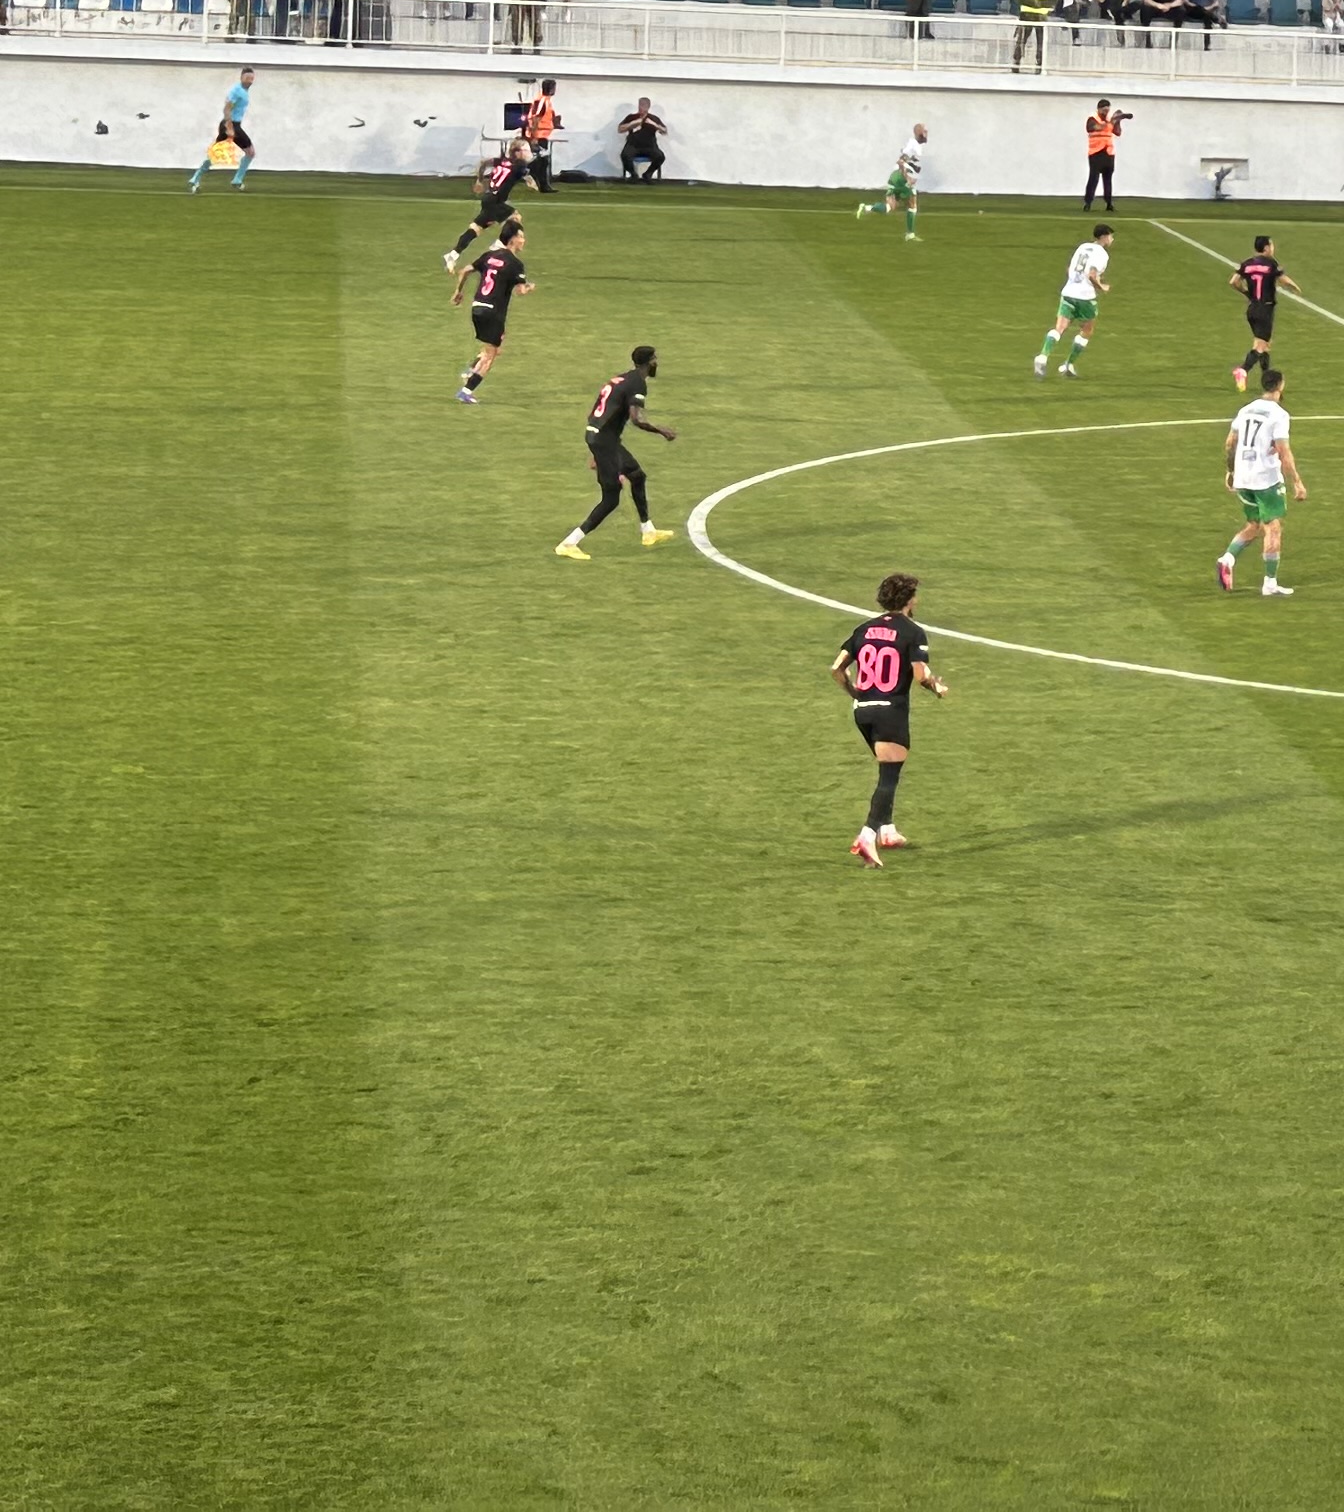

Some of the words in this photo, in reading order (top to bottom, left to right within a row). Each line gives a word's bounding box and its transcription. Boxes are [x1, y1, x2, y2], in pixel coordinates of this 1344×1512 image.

[481, 268, 498, 296] 5
[1250, 275, 1264, 300] 7
[1243, 418, 1264, 448] 17
[857, 643, 900, 693] 80
